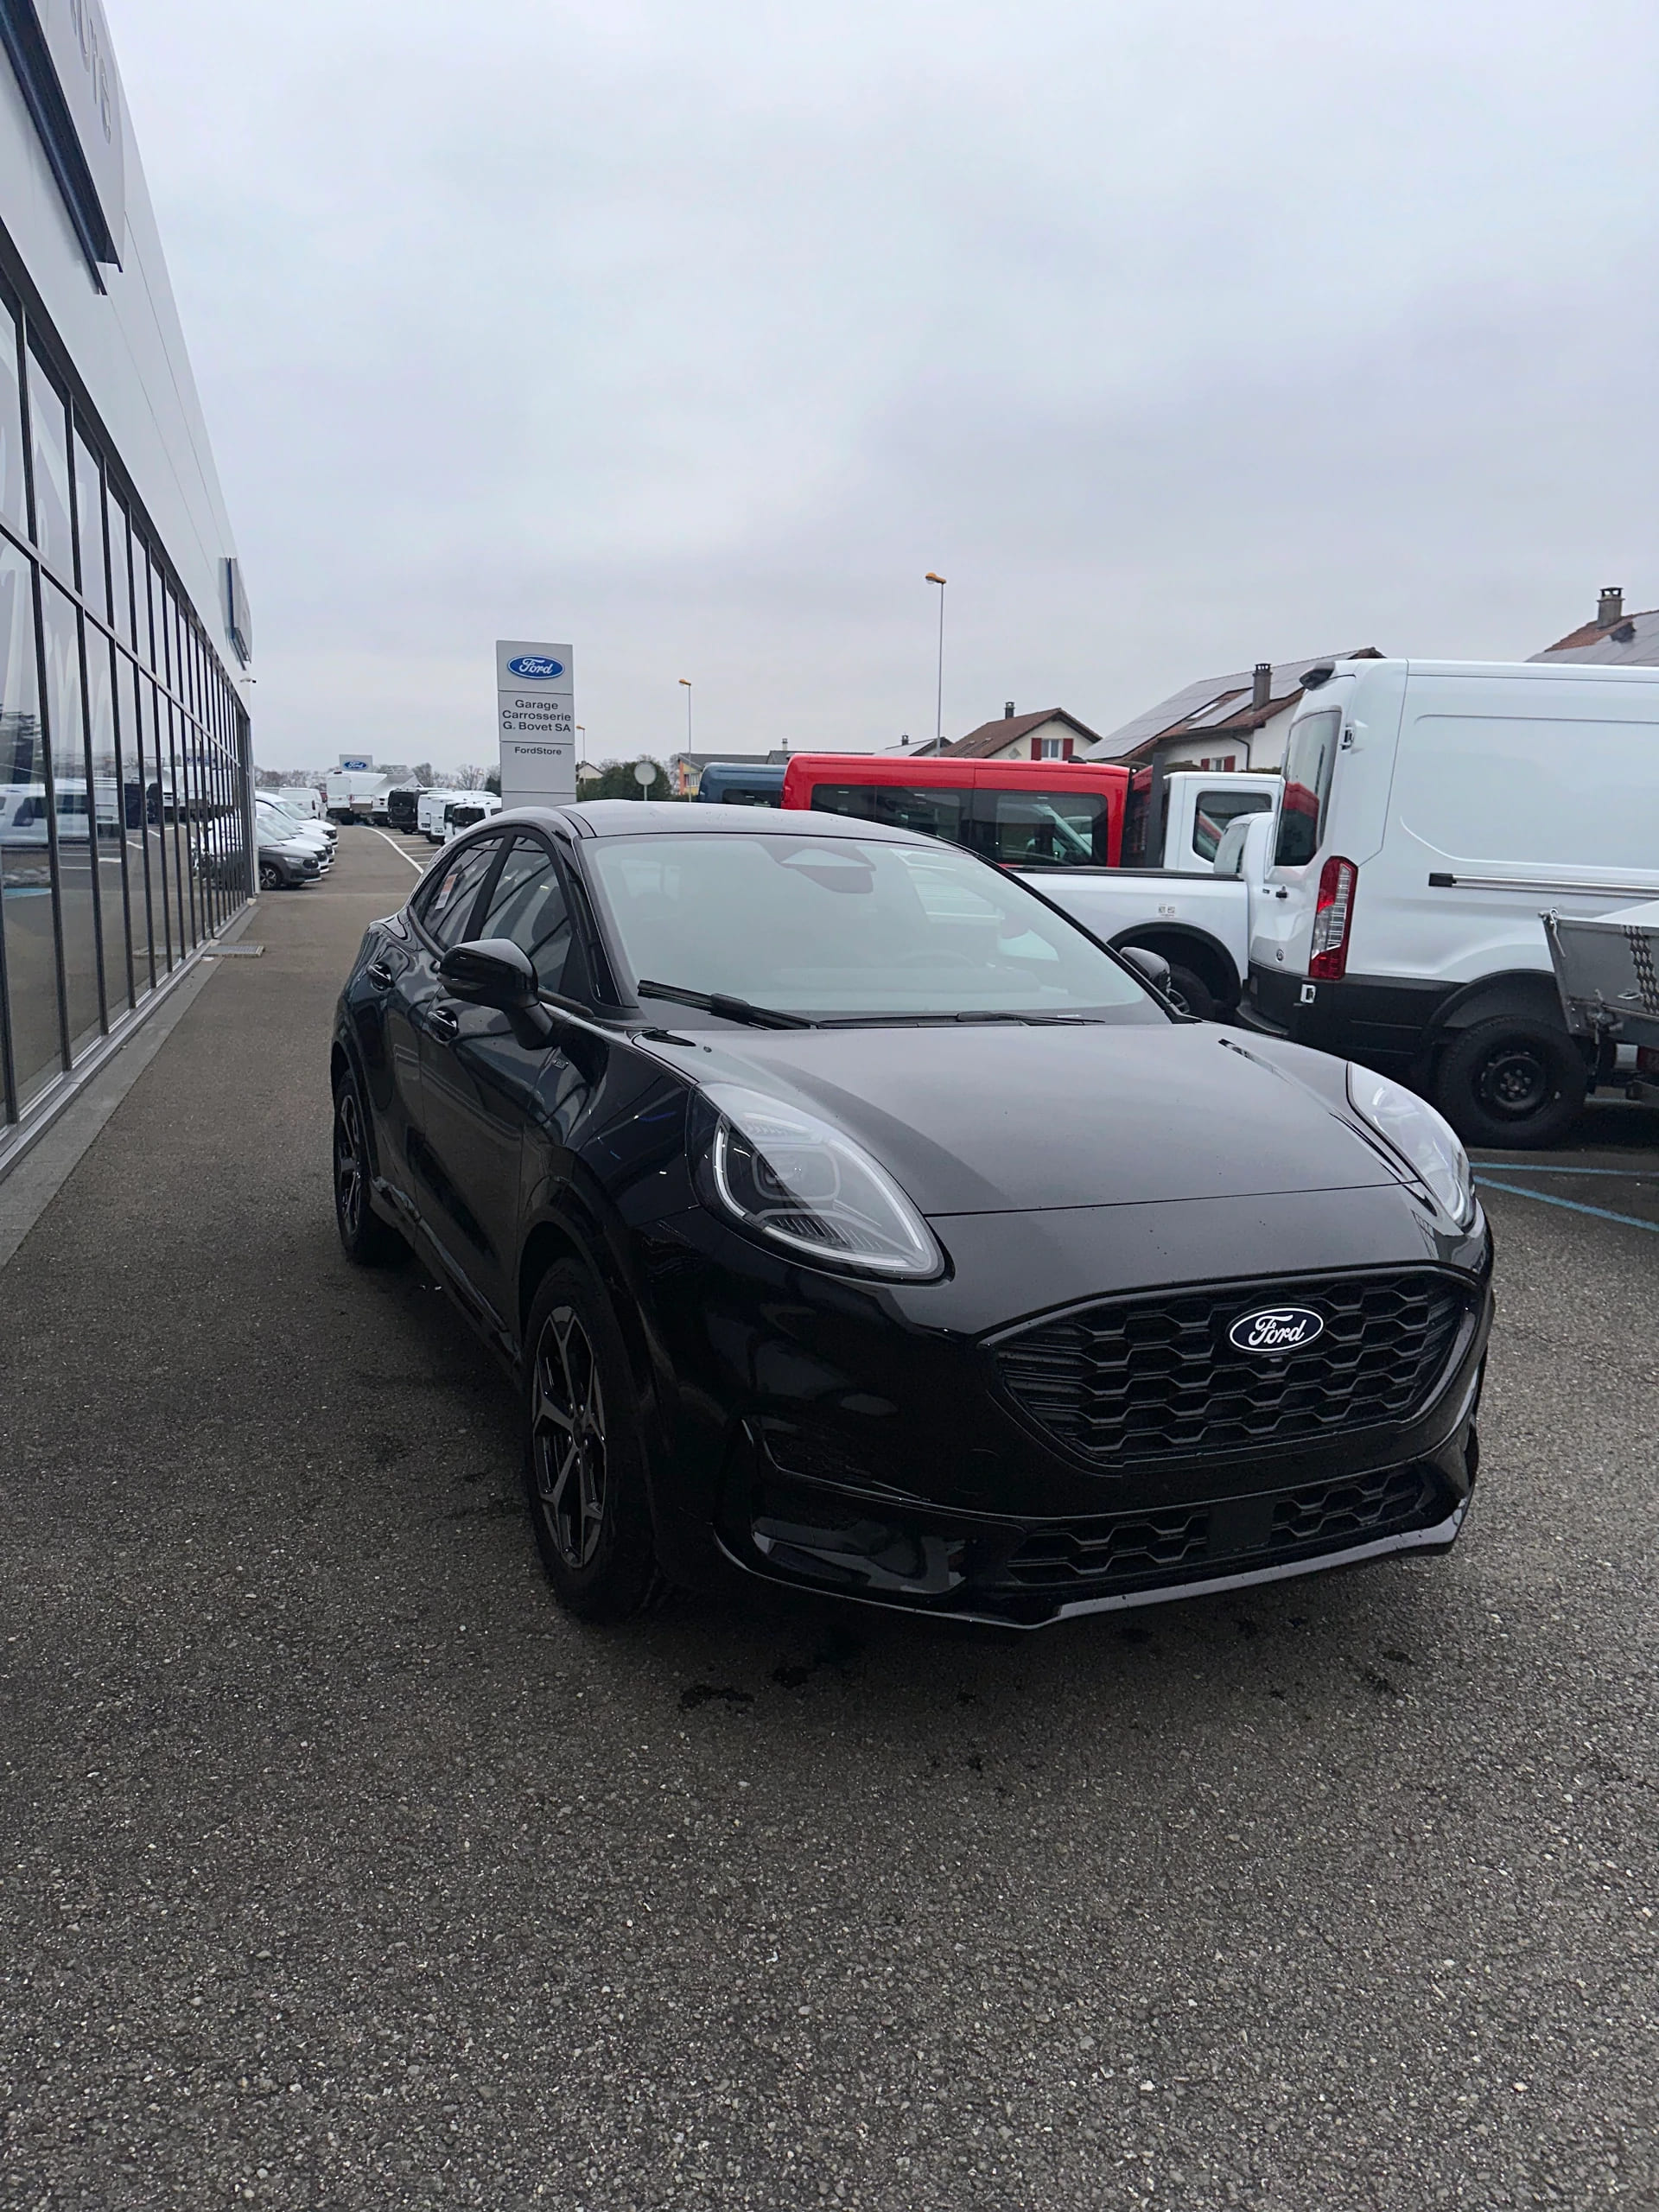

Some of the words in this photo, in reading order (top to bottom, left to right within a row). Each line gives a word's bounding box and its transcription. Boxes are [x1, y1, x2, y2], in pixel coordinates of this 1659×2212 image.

[518, 658, 553, 674] Ford
[515, 699, 558, 711] Garage
[502, 709, 571, 721] Carrosserie
[503, 721, 516, 730] G.
[518, 721, 552, 731] Bovet
[555, 723, 571, 732] SA
[514, 747, 562, 755] FordStore
[1249, 1314, 1307, 1346] Ford
